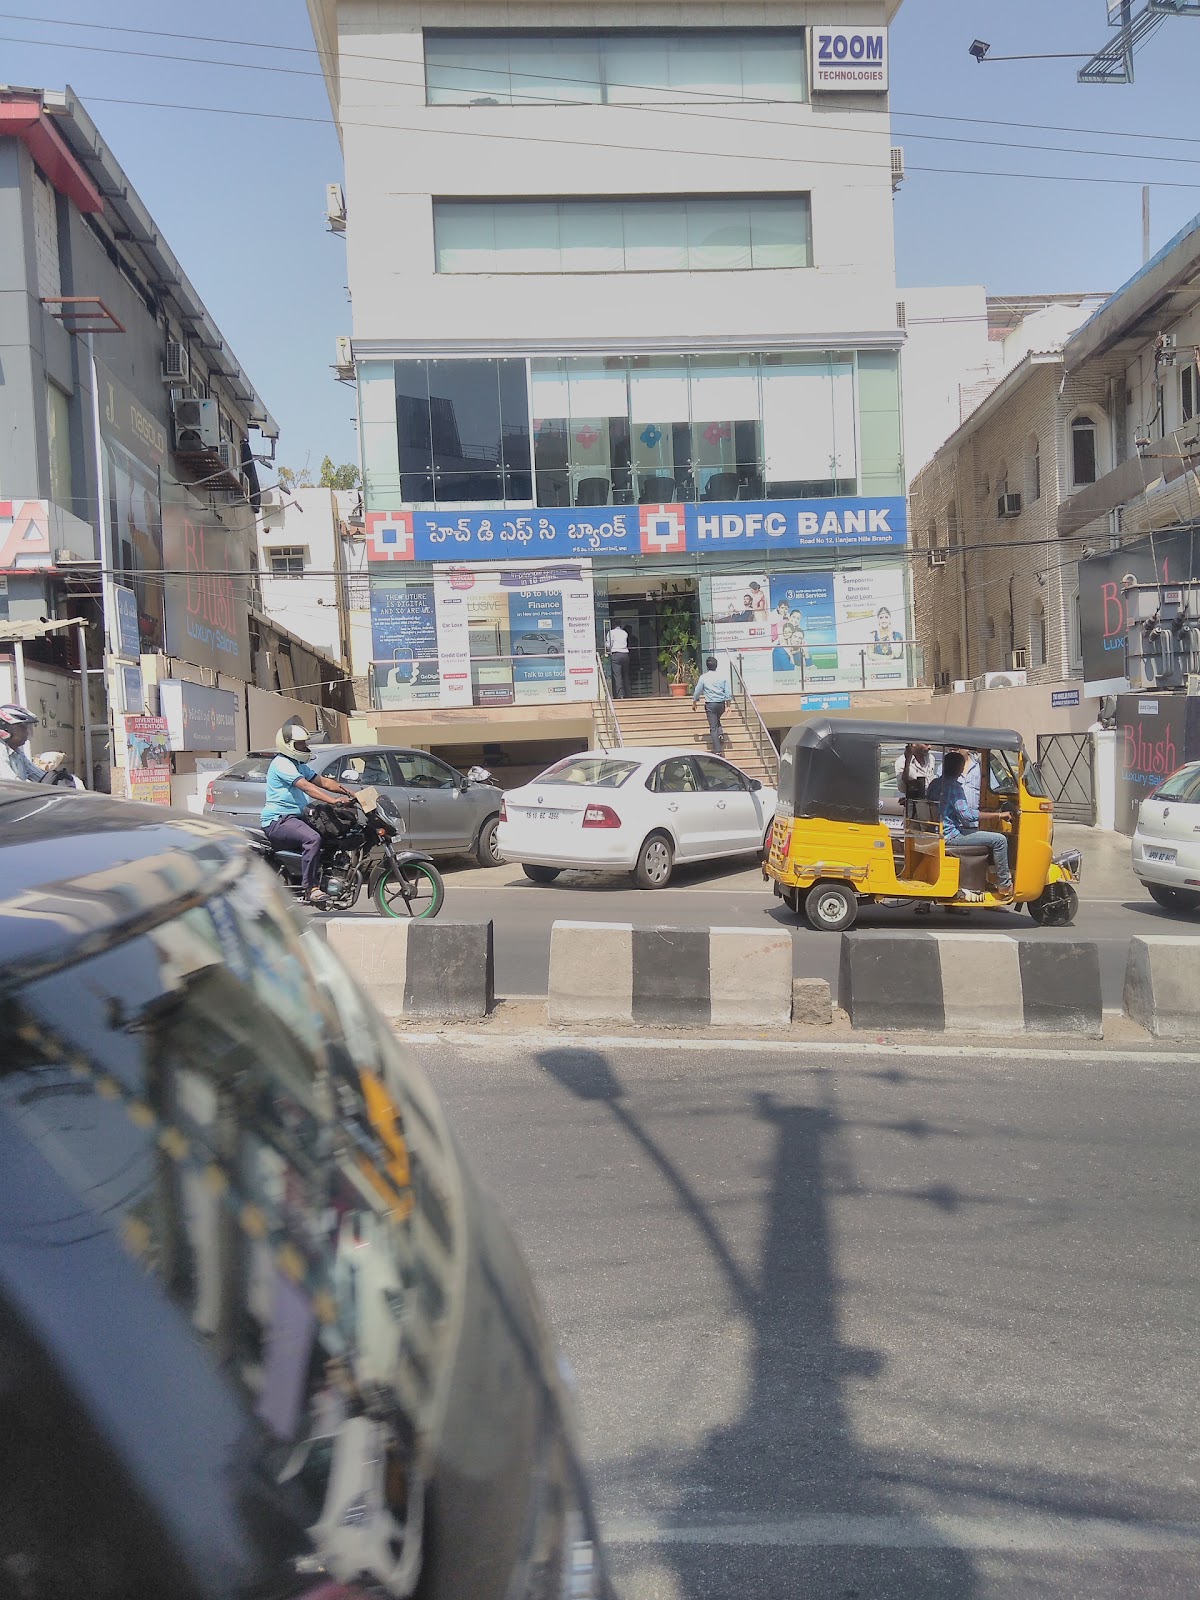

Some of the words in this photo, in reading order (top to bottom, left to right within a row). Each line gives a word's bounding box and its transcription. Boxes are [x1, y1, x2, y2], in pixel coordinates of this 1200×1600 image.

[818, 35, 883, 60] ZOOM
[818, 71, 883, 80] TECHNOLOGIES
[477, 519, 494, 542] డి
[538, 518, 556, 541] సి
[697, 512, 787, 539] HDFC
[797, 508, 892, 535] BANK
[872, 534, 892, 542] Branch
[183, 517, 237, 634] Blush
[186, 614, 215, 656] Luxury
[1122, 720, 1177, 774] Blush
[1122, 770, 1148, 786] Luxury
